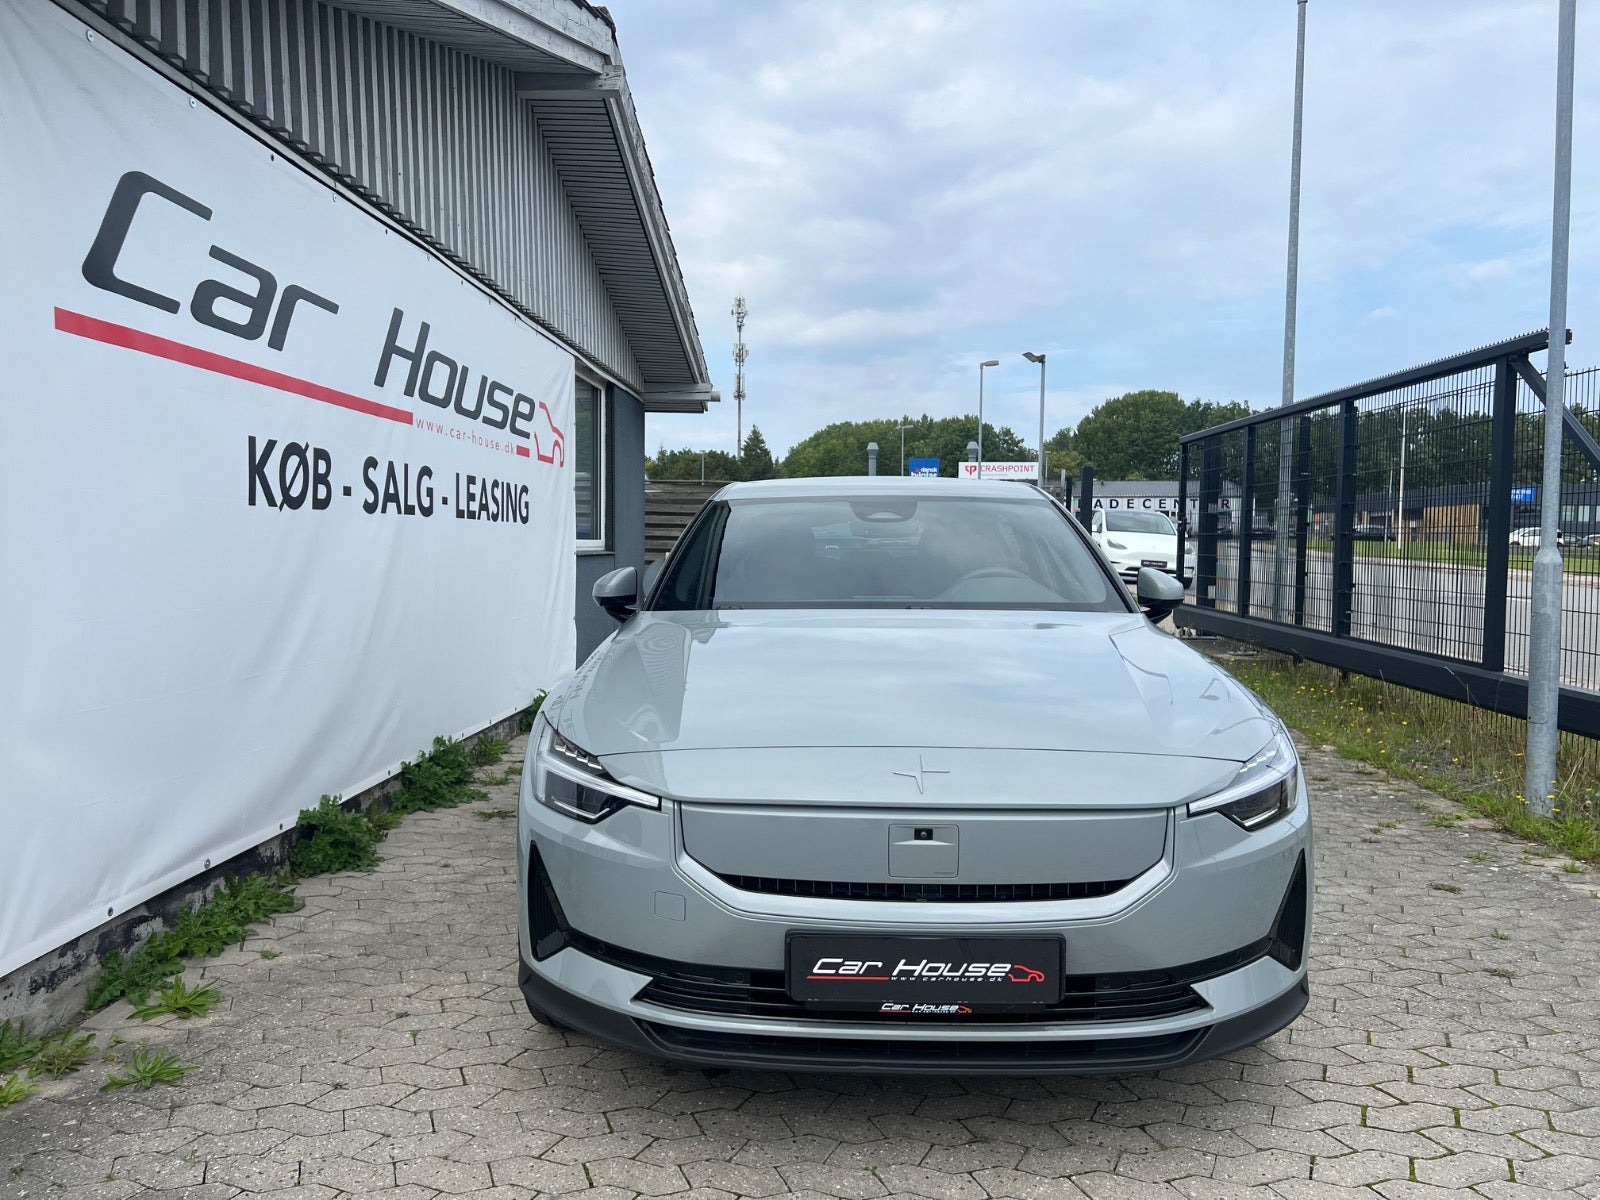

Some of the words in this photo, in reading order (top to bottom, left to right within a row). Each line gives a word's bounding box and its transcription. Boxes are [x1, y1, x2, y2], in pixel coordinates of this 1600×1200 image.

[81, 171, 340, 352] Car
[374, 307, 536, 440] House
[416, 417, 516, 455] www.car-house.dk
[980, 464, 1035, 473] CRASHPOINT
[248, 435, 333, 512] KØB
[363, 455, 434, 518] SALG
[456, 472, 529, 525] LEASING
[1078, 498, 1230, 509] ADECENTR
[812, 958, 883, 975] Car
[892, 959, 1012, 976] House
[881, 1003, 910, 1011] Car
[912, 1003, 959, 1012] House
